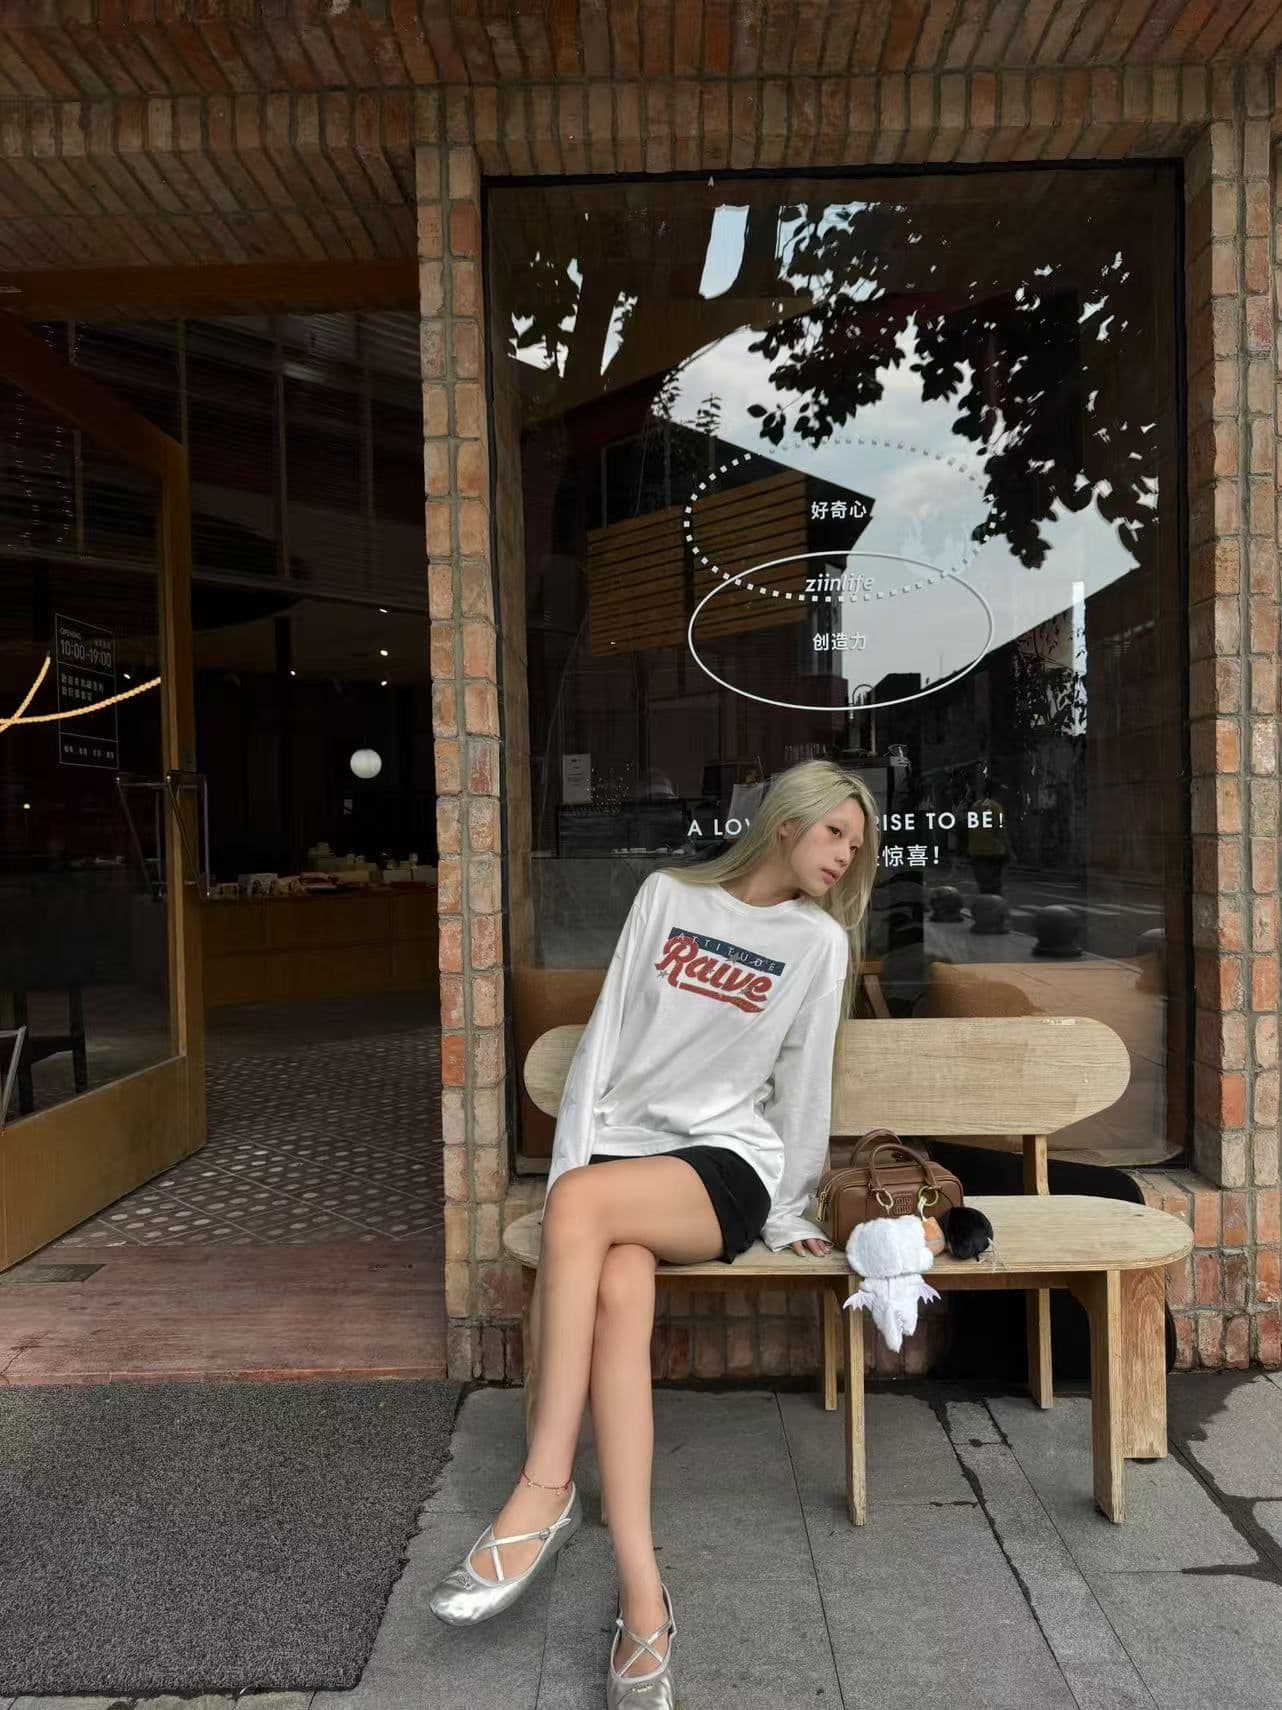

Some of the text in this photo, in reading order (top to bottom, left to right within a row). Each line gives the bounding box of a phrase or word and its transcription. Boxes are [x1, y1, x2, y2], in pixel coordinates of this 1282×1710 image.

[811, 500, 867, 521] 好奇心
[805, 573, 873, 593] ziinlife
[812, 632, 866, 651] 创造力
[687, 819, 703, 836] A
[925, 812, 956, 830] TO
